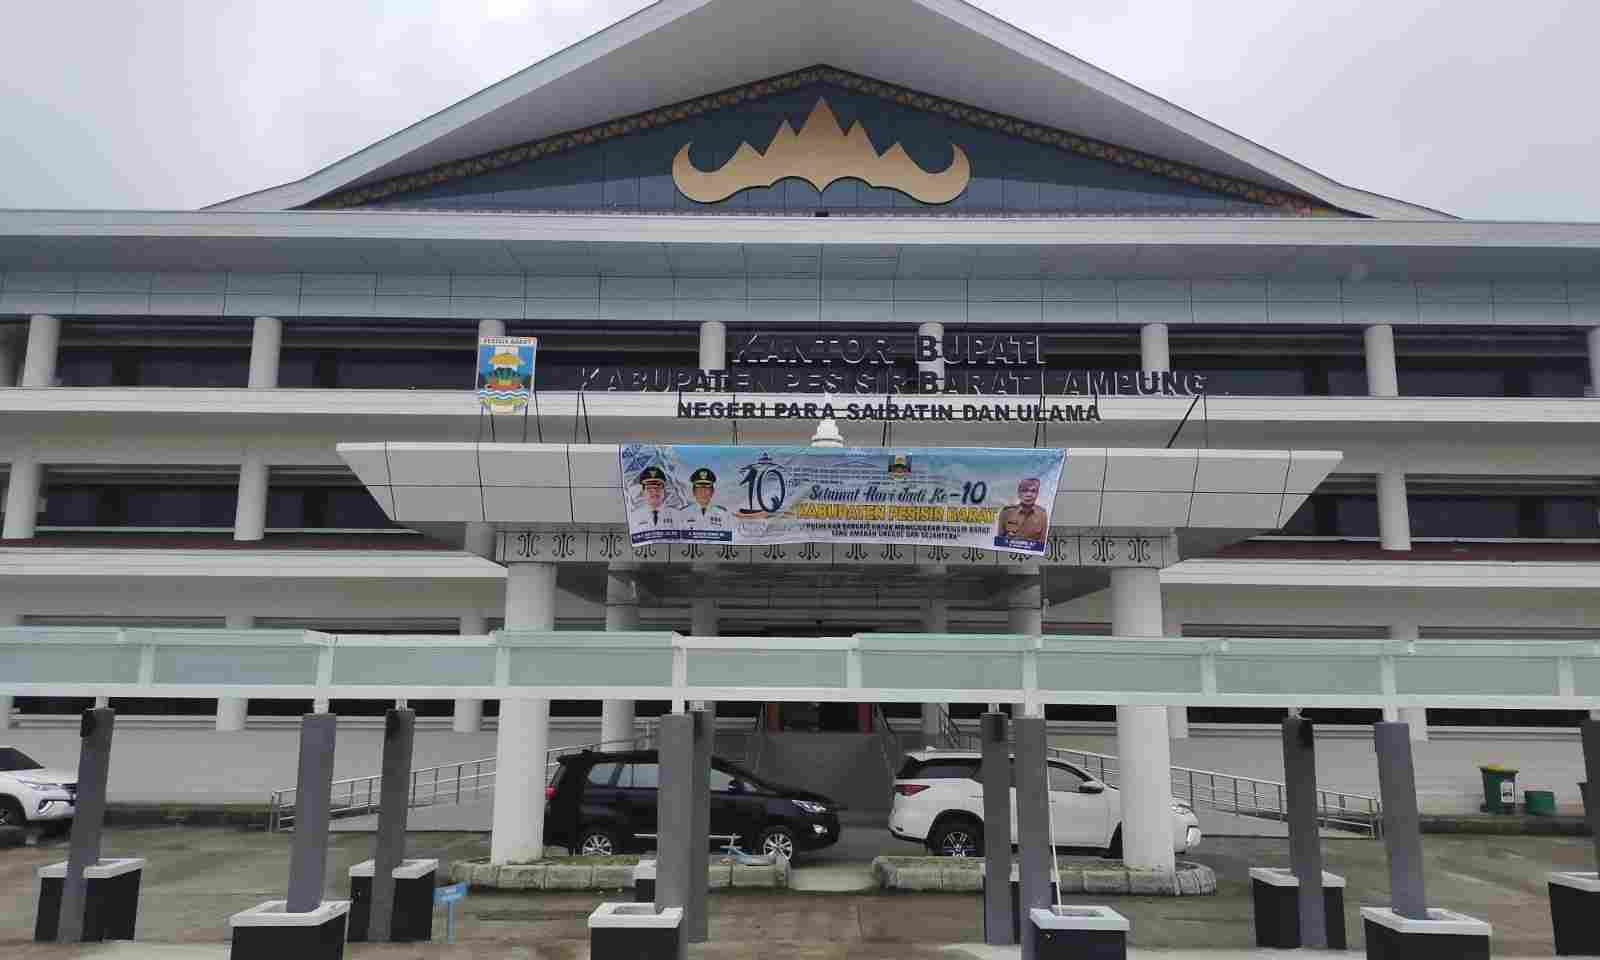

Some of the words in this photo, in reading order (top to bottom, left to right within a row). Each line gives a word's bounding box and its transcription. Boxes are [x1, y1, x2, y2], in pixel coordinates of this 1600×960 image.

[732, 334, 893, 364] KANTOR
[914, 335, 1046, 364] BUPATI
[579, 367, 769, 393] KABUPATEN
[915, 370, 1033, 395] BARAT
[677, 402, 769, 418] NEGERI
[775, 402, 836, 419] PARA
[846, 404, 953, 421] SAIBATIN
[962, 404, 1015, 421] DAN
[1017, 404, 1102, 422] ULAMA
[799, 502, 885, 521] KABUPATEN
[889, 504, 945, 522] PESISIR
